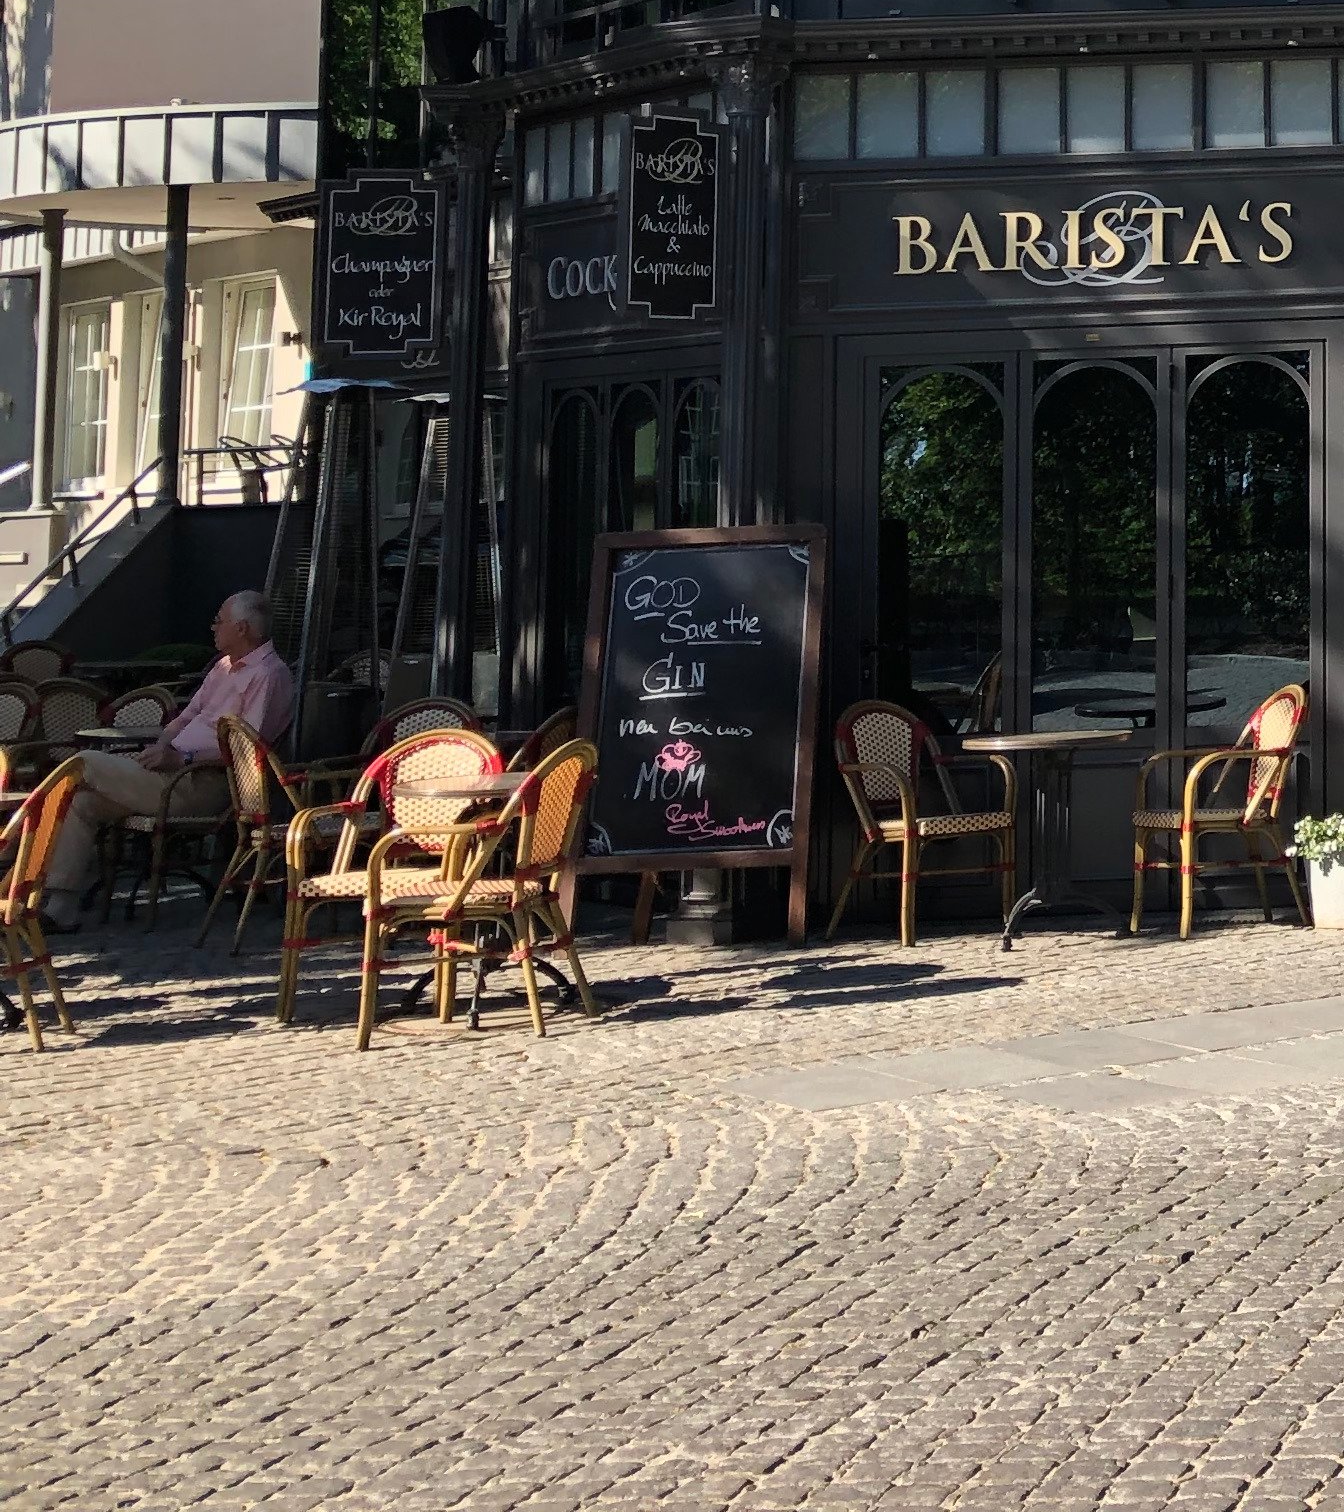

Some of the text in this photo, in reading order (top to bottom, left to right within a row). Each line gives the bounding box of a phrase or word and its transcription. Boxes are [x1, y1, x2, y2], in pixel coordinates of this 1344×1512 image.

[657, 194, 694, 215] Latte
[638, 213, 710, 236] Macchiato
[892, 199, 1293, 276] BARISTA'S
[666, 236, 681, 253] &
[634, 256, 712, 285] Cappuccino
[368, 284, 394, 298] oder
[338, 303, 422, 339] Kir Royal
[625, 575, 700, 611] GOD
[661, 603, 762, 644] Save the
[642, 653, 707, 694] GIN
[633, 760, 707, 802] MOM
